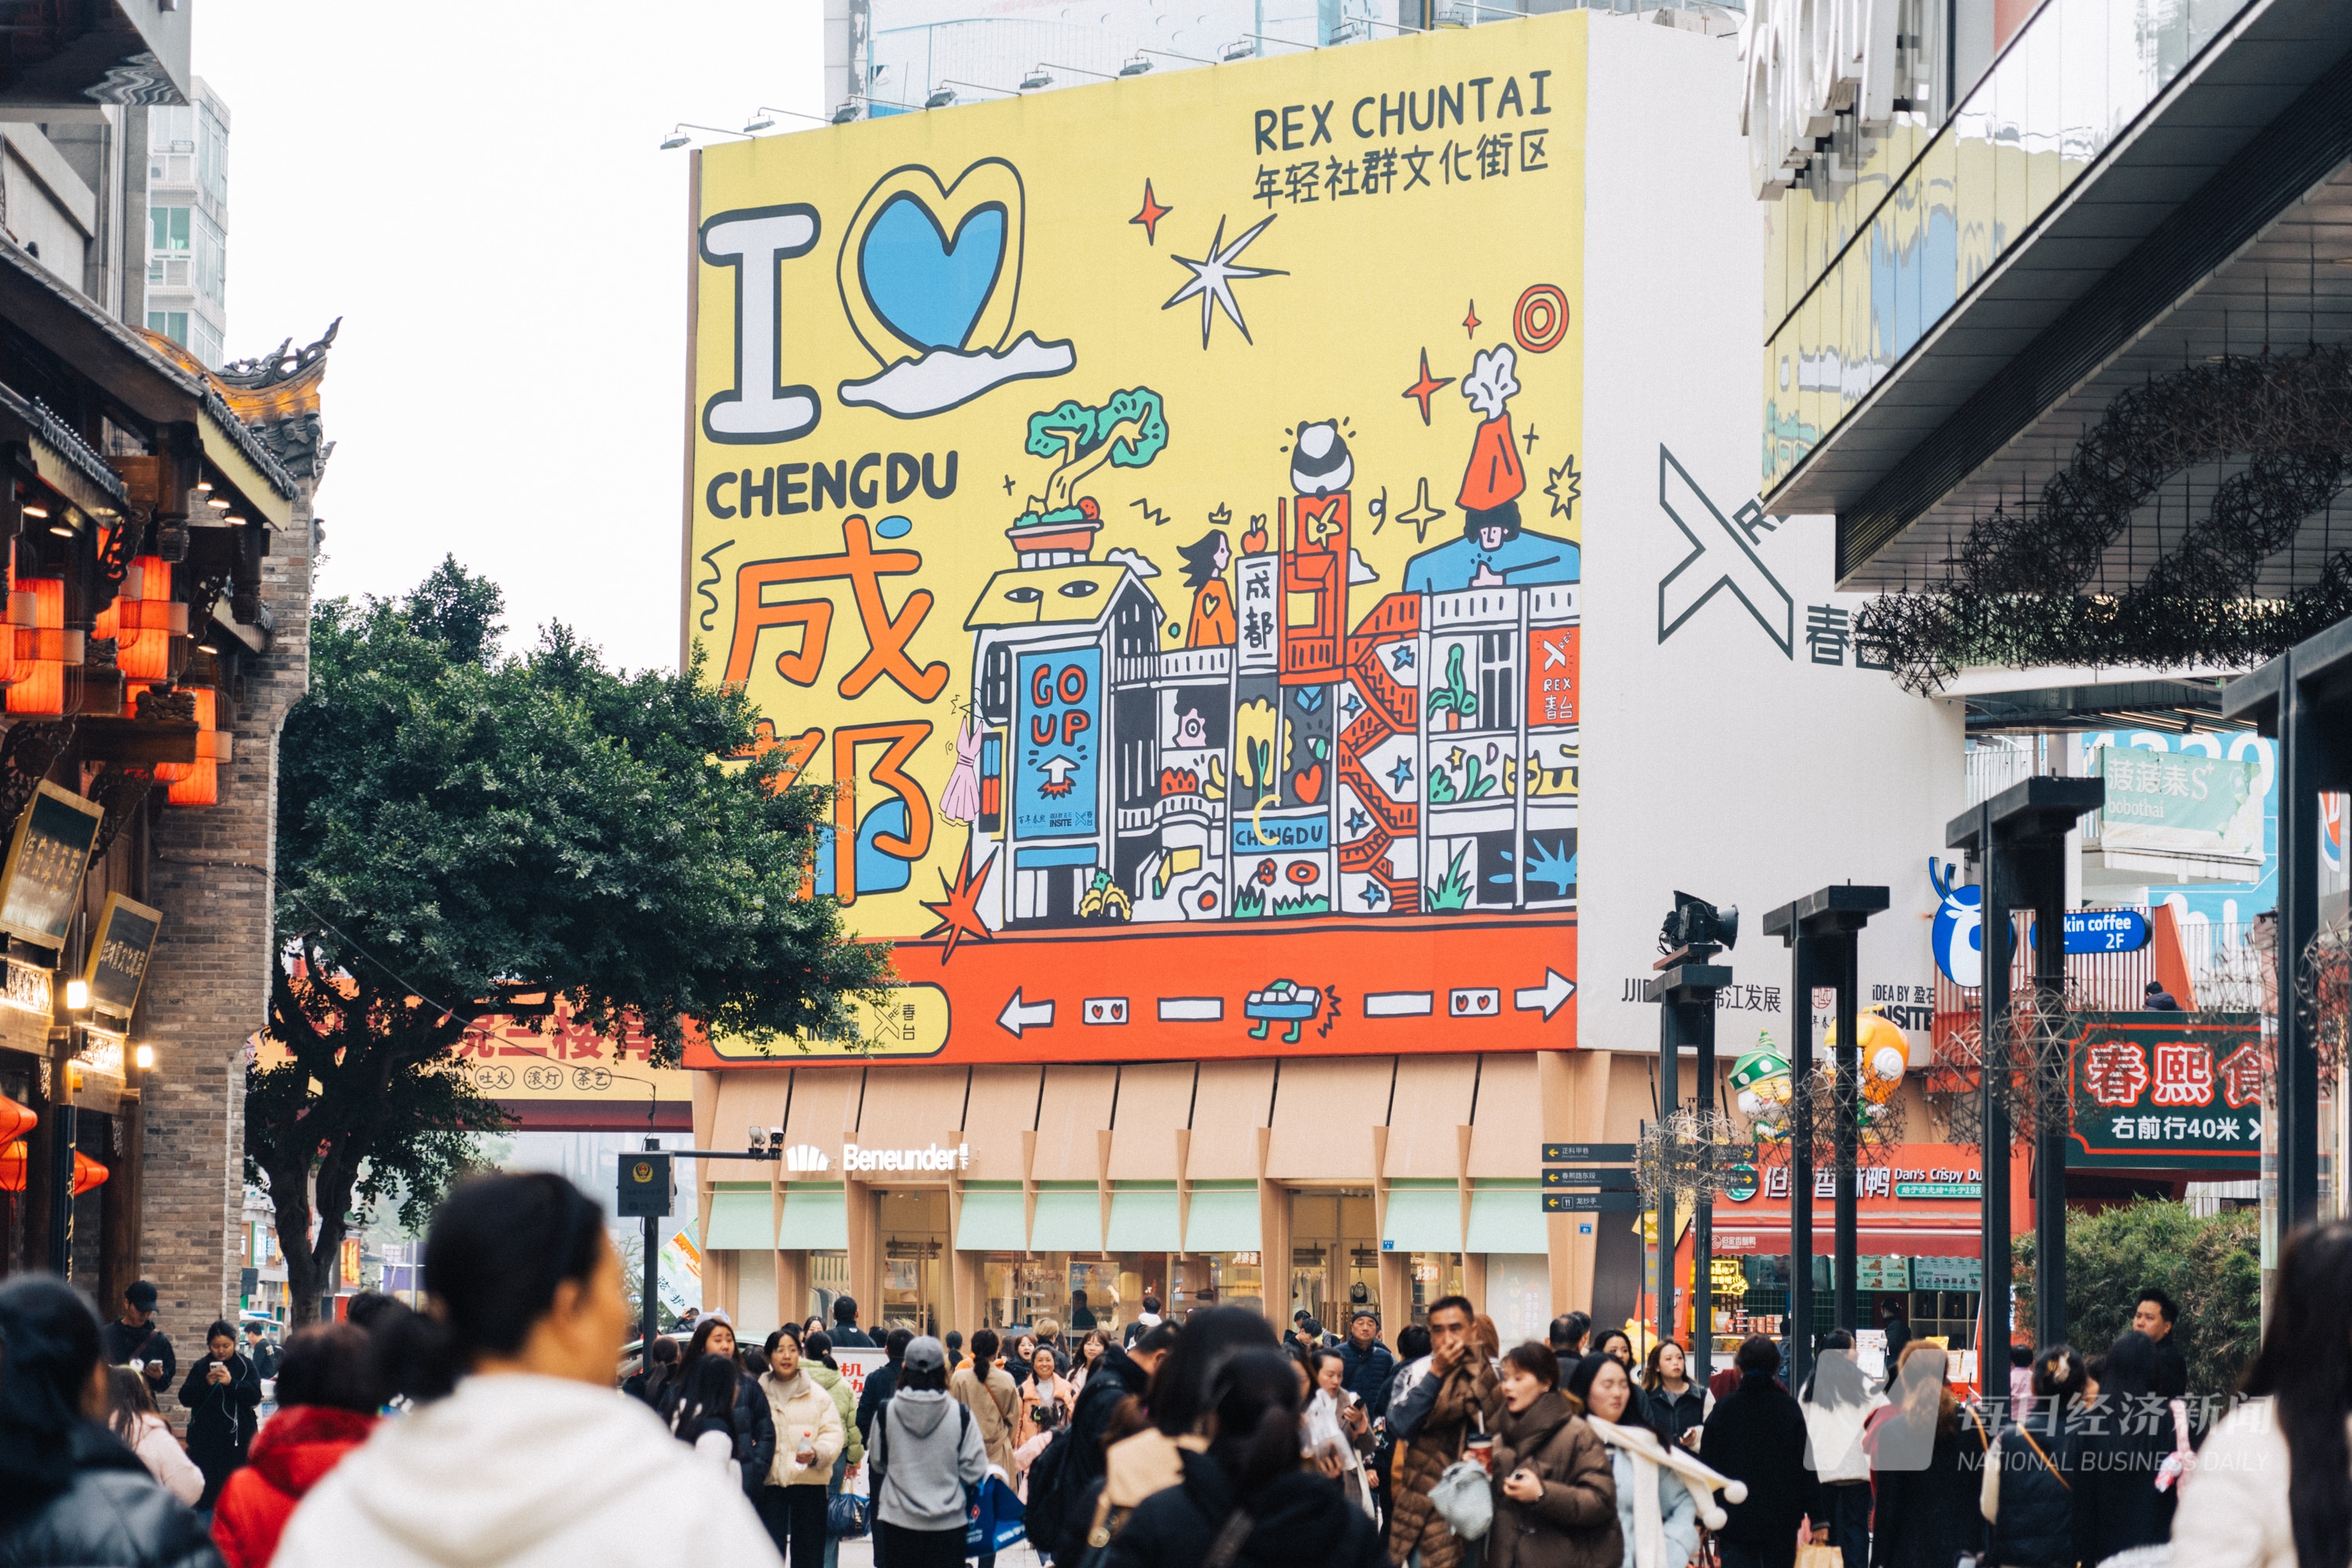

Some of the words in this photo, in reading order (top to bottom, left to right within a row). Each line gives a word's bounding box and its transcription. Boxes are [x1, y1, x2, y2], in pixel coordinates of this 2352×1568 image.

[1254, 100, 1334, 155] REX
[1352, 70, 1552, 140] CHUNTAI
[1254, 128, 1549, 209] 年轻社群文化街区
[699, 202, 822, 445] I
[706, 450, 959, 519] CHENGDU
[1244, 571, 1273, 650] 成都
[1031, 664, 1088, 706] GO
[1543, 677, 1572, 692] REX
[1544, 694, 1573, 720] 春台
[1031, 710, 1091, 746] UP
[2107, 795, 2165, 818] bobothai
[1050, 818, 1072, 828] INSITE
[2088, 913, 2132, 931] coffee
[2106, 934, 2125, 949] 2F
[1897, 985, 1909, 1002] BY
[902, 1004, 915, 1040] 春台
[1874, 1004, 1934, 1031] NSITE
[479, 1071, 510, 1085] 吐火
[528, 1071, 560, 1085] 滚灯
[577, 1071, 608, 1086] 茶艺
[2111, 1116, 2241, 1142] 右前行40米
[843, 1142, 957, 1171] Beneunder
[1764, 1167, 1890, 1197] 但香鸭
[1894, 1168, 1926, 1180] Dan's
[1929, 1167, 1964, 1183] Crispy
[1968, 1169, 1982, 1180] Du
